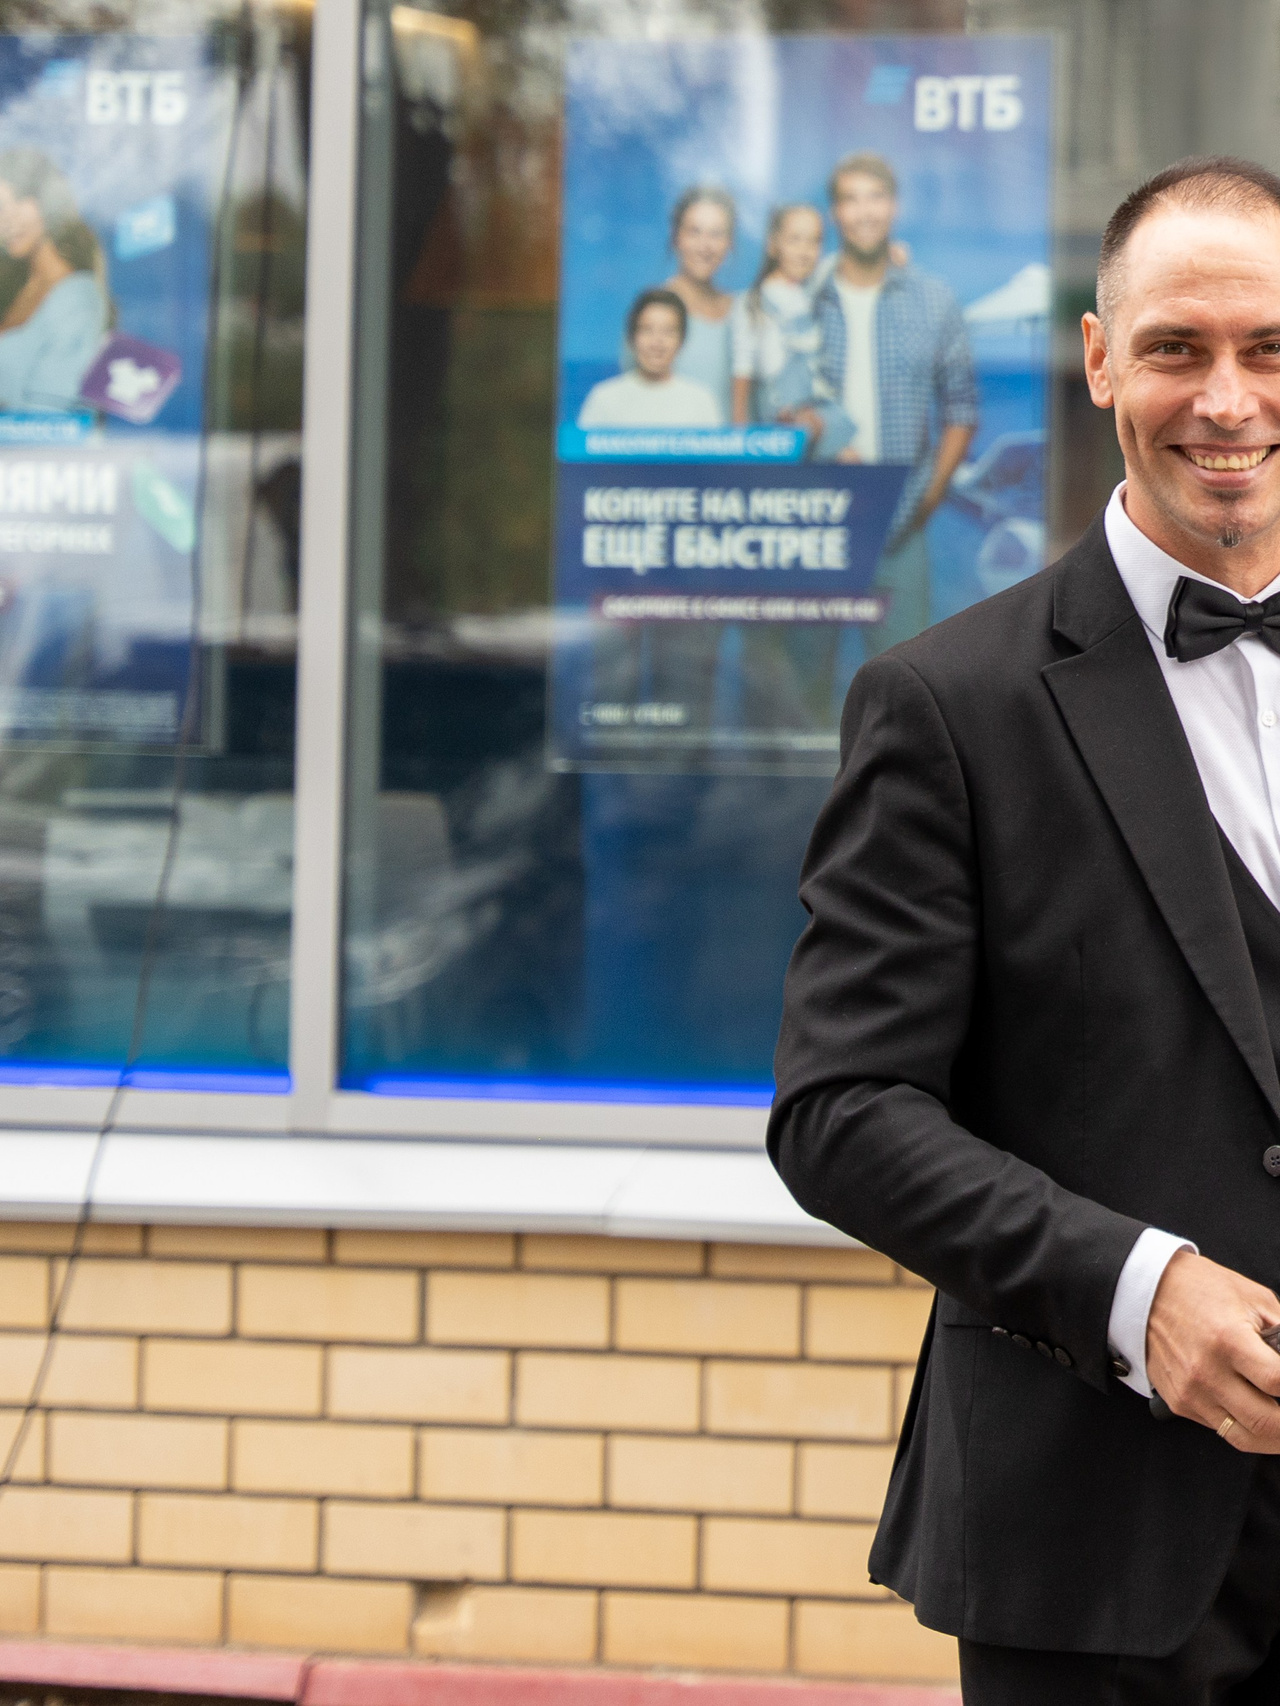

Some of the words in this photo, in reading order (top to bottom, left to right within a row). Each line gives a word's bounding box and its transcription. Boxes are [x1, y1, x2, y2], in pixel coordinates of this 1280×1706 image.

[86, 71, 186, 125] ВТБ
[913, 74, 1024, 132] ВТБ
[0, 460, 117, 515] ЯМИ
[583, 486, 698, 522] КОПИТЕ
[700, 487, 746, 523] НА
[748, 487, 853, 524] МЕЧТУ
[582, 519, 669, 576] ЕЩЁ
[674, 524, 850, 571] БЫСТРЕЕ
